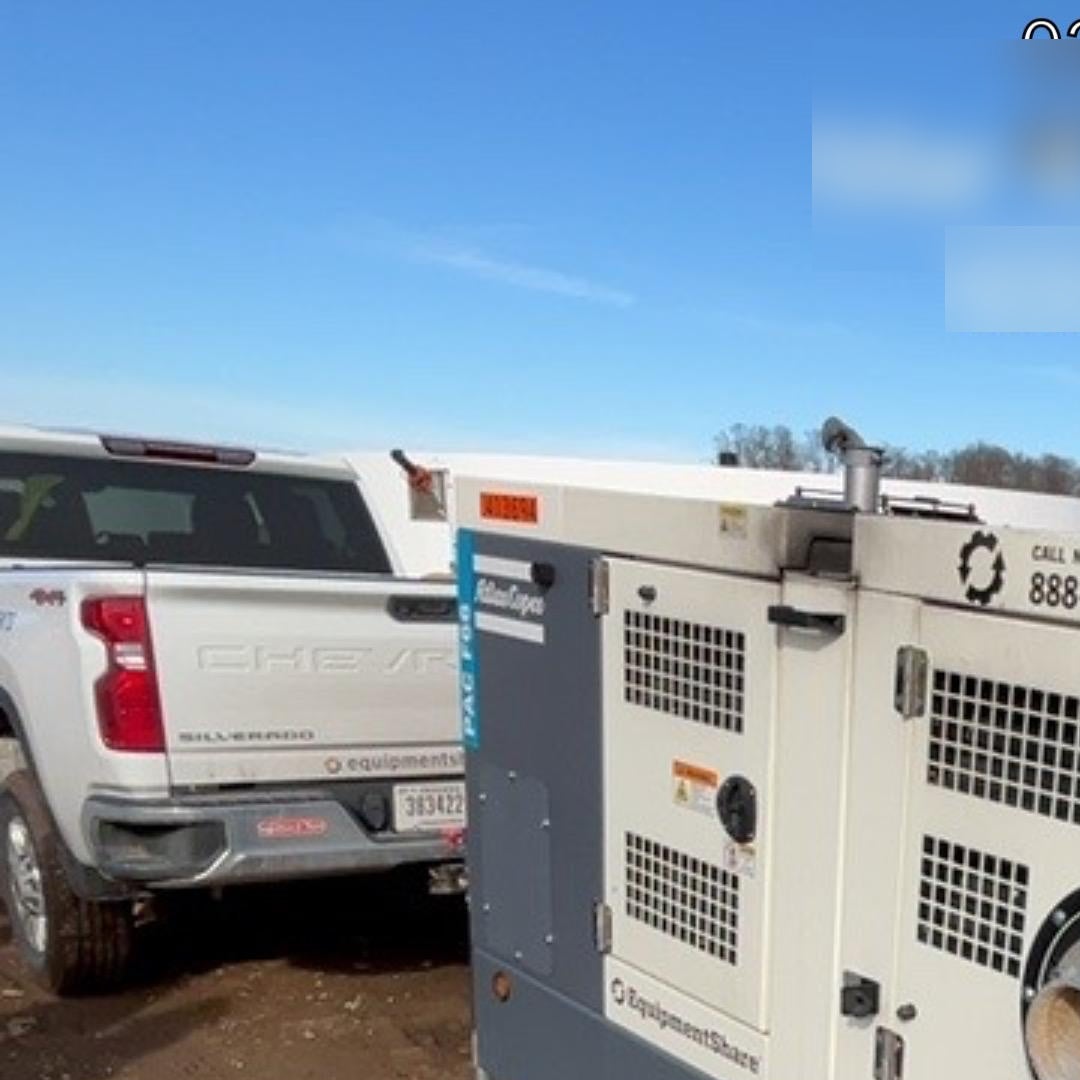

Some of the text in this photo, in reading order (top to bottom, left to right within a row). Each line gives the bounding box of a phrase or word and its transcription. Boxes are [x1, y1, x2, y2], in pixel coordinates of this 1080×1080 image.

[1031, 545, 1066, 564] CALL
[178, 730, 315, 742] SILVERADO
[627, 986, 760, 1074] EquipmentShare
